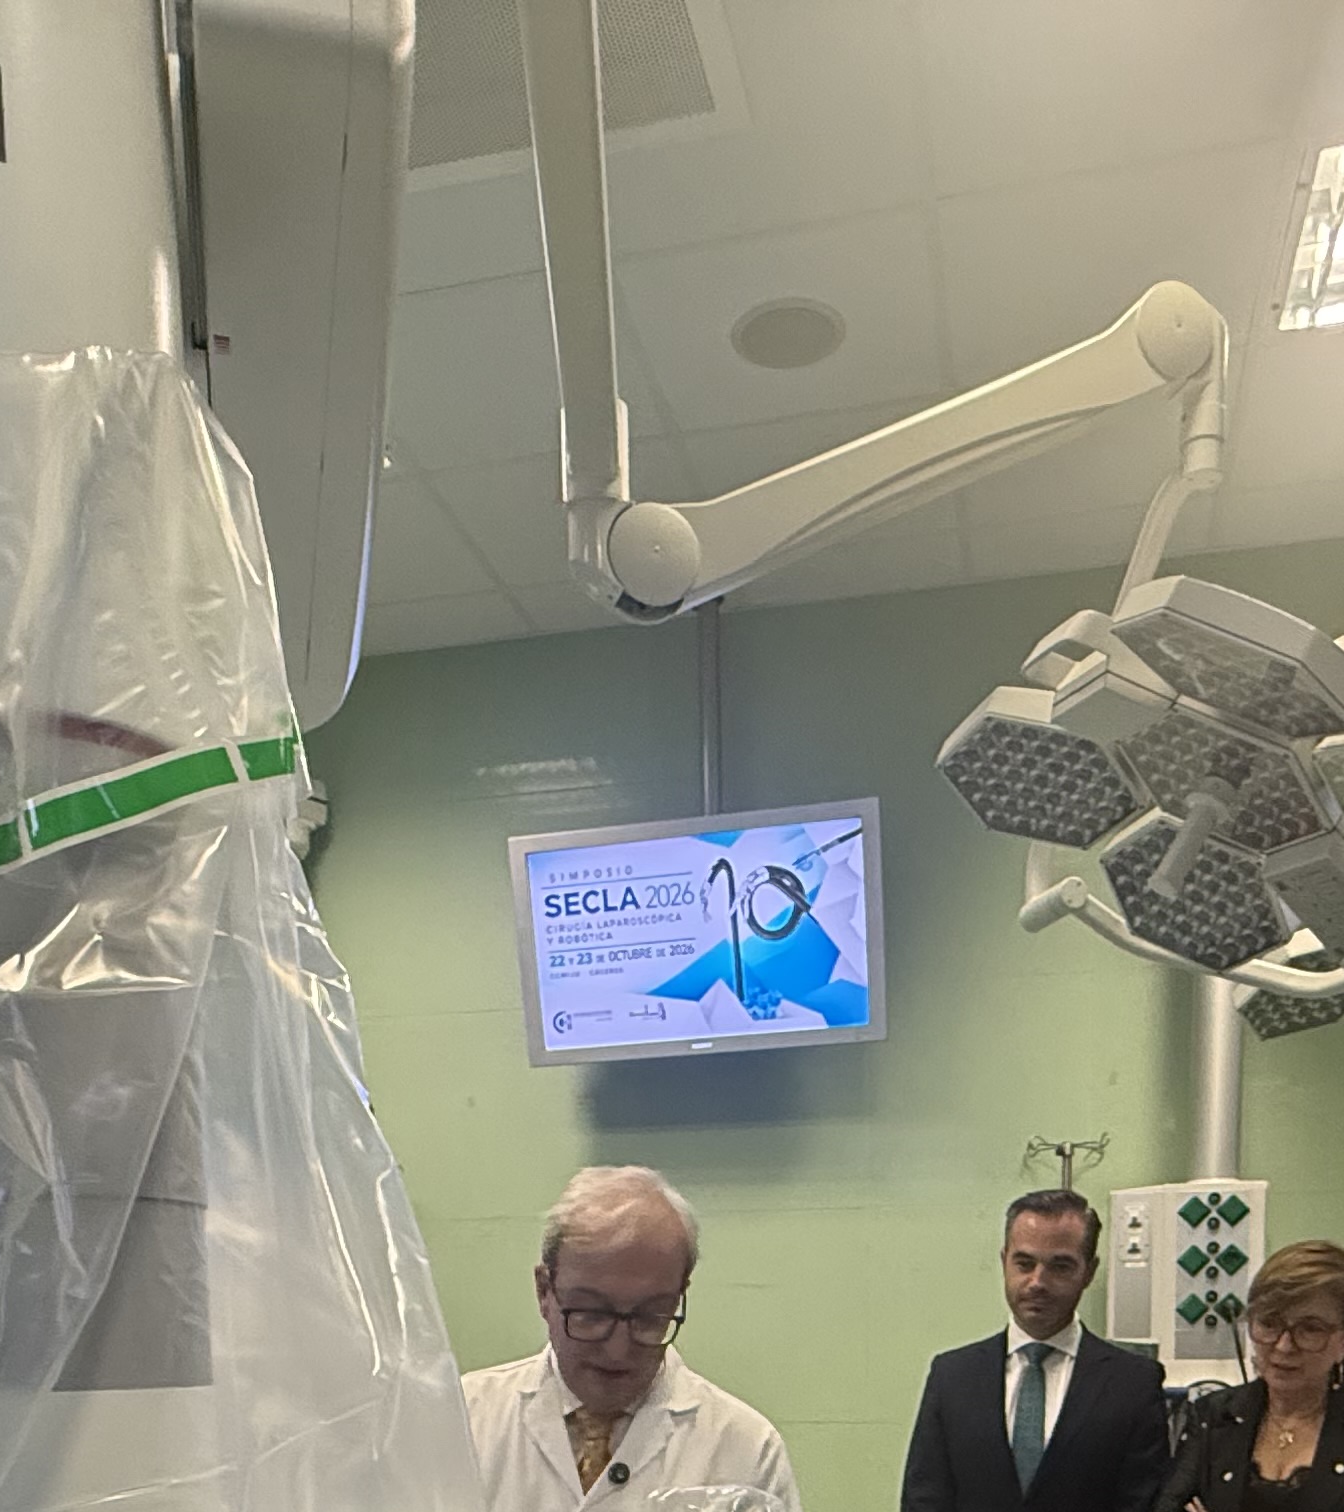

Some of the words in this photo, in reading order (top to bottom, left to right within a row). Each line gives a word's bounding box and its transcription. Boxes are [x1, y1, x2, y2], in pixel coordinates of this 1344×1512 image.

[549, 865, 633, 884] SIMPOSIO
[544, 886, 641, 918] SECLA
[645, 882, 695, 909] 2026
[549, 955, 566, 967] 22
[576, 952, 593, 965] 23
[608, 946, 653, 962] OCTUBRE
[669, 943, 695, 957] 2026
